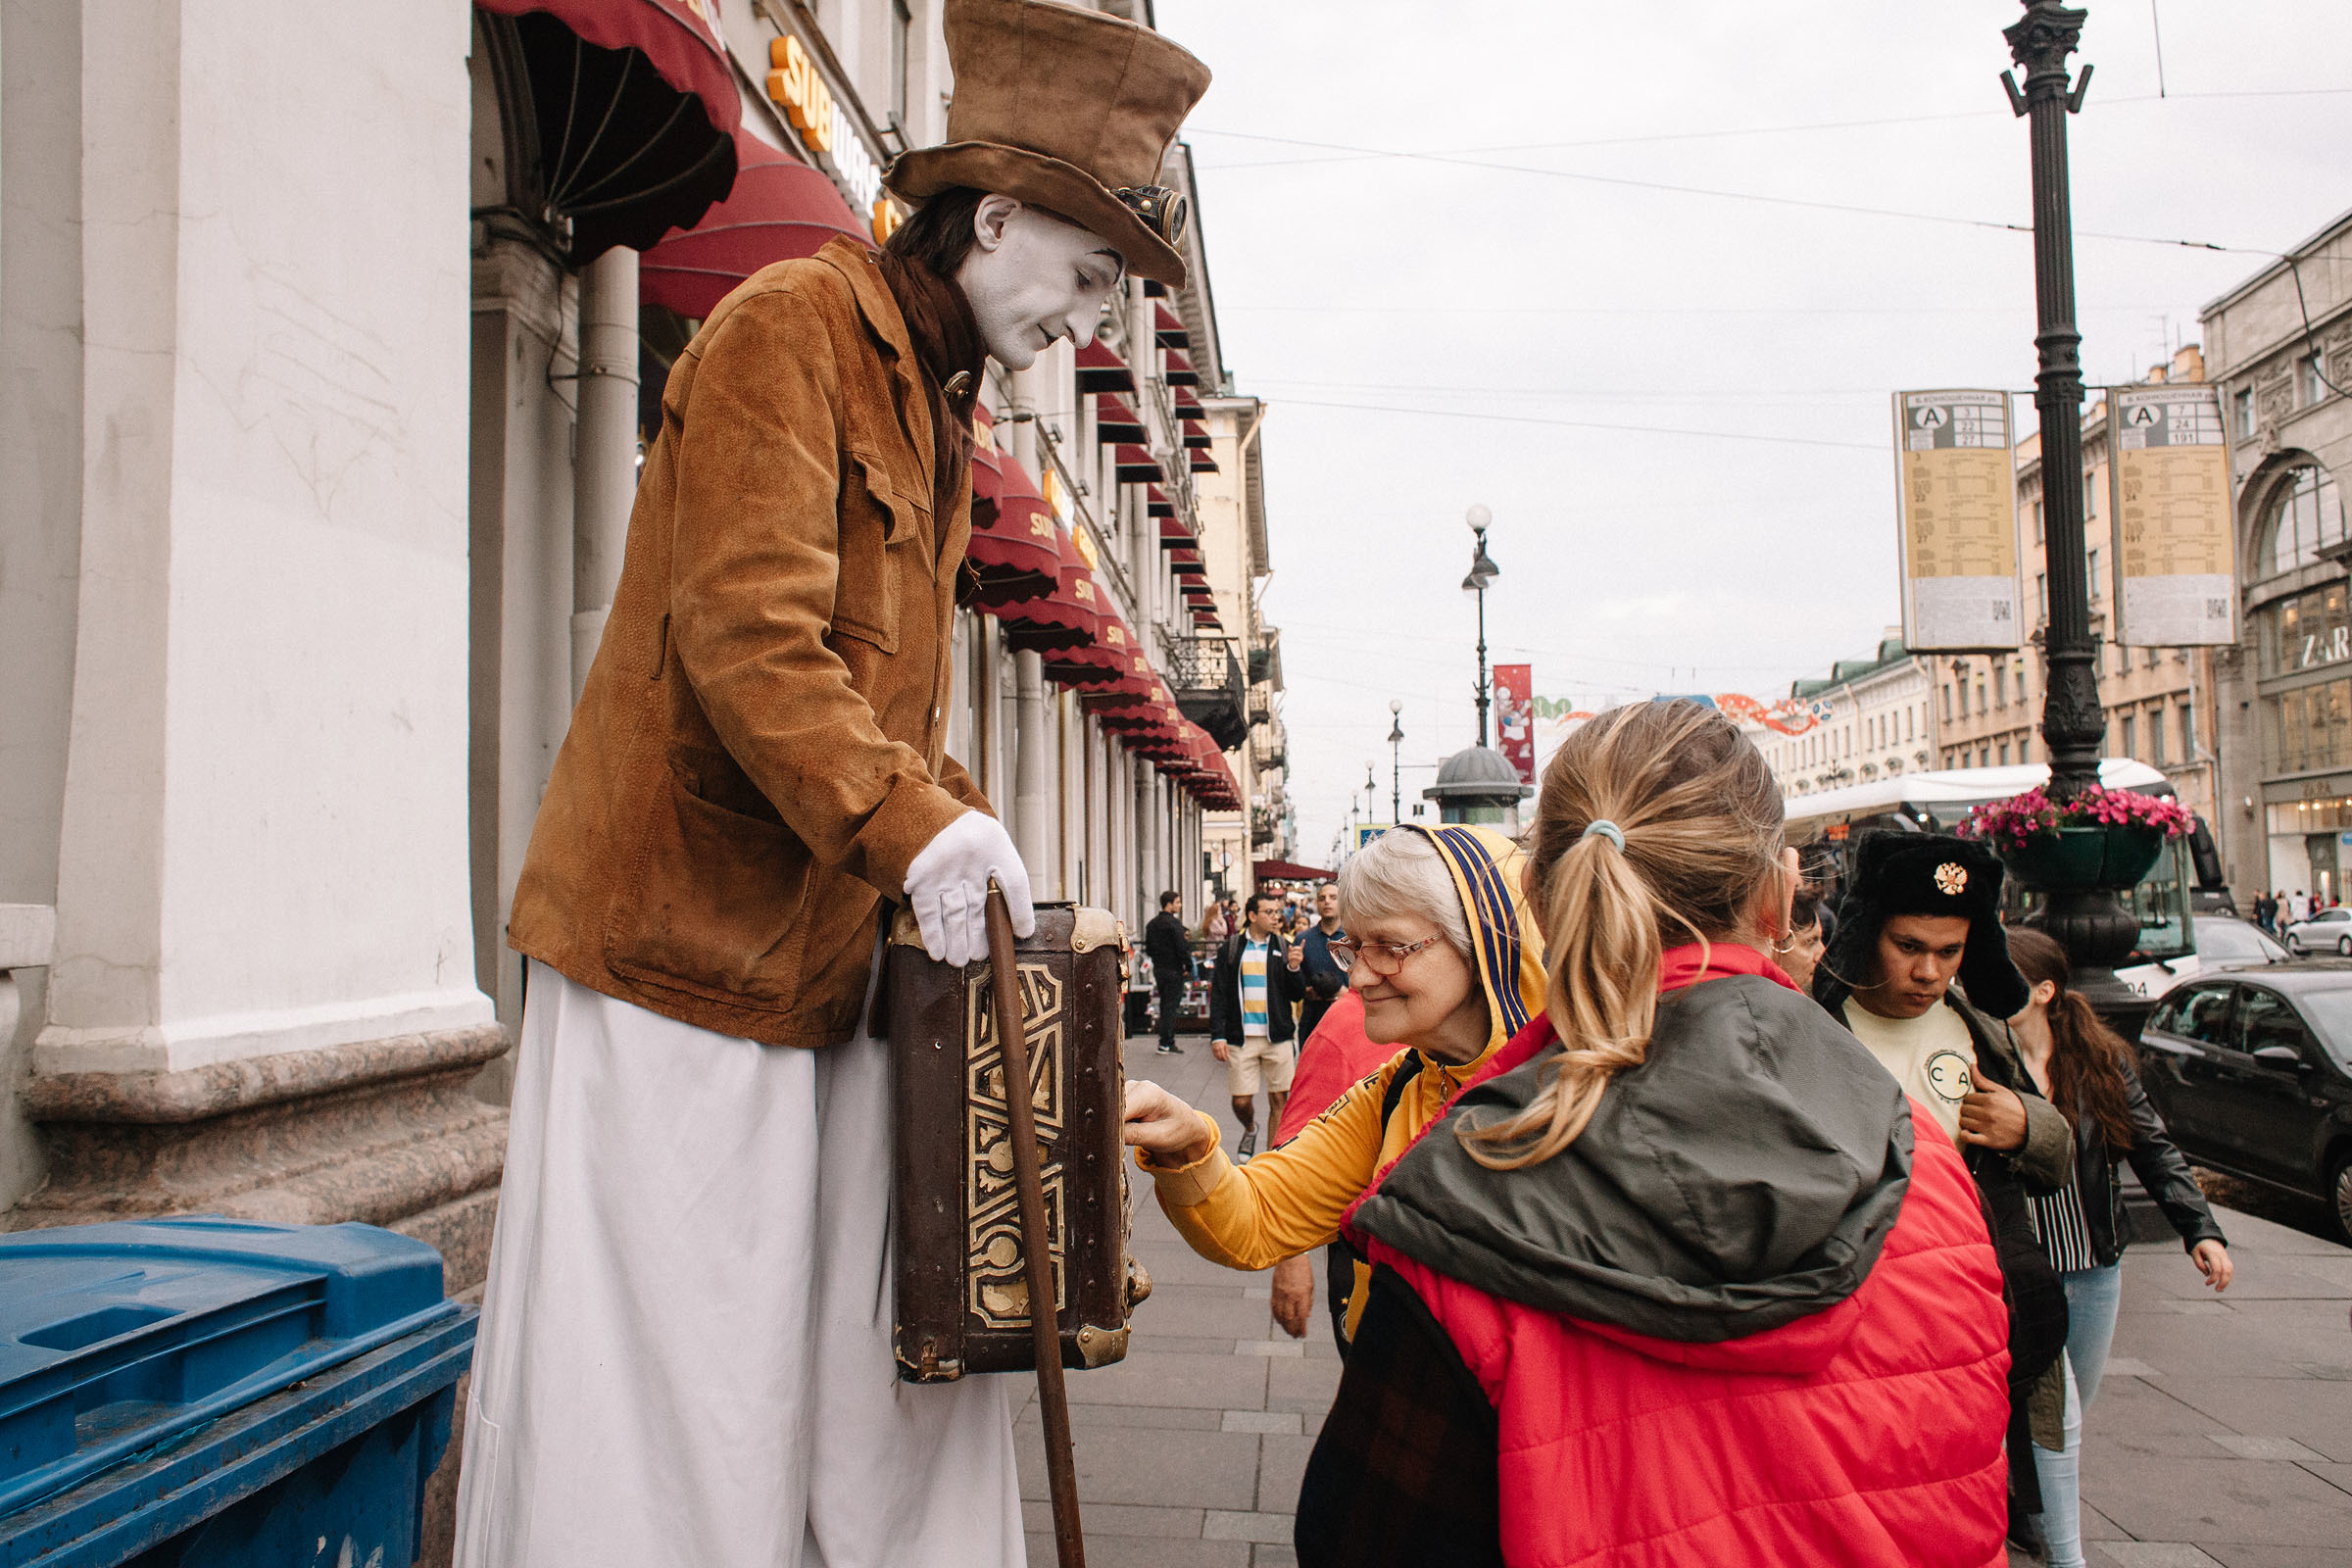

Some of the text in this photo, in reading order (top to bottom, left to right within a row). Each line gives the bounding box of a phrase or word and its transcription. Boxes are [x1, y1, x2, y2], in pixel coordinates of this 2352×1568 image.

[767, 34, 881, 220] SUBWAY
[1924, 408, 1940, 425] А
[2135, 407, 2153, 424] А
